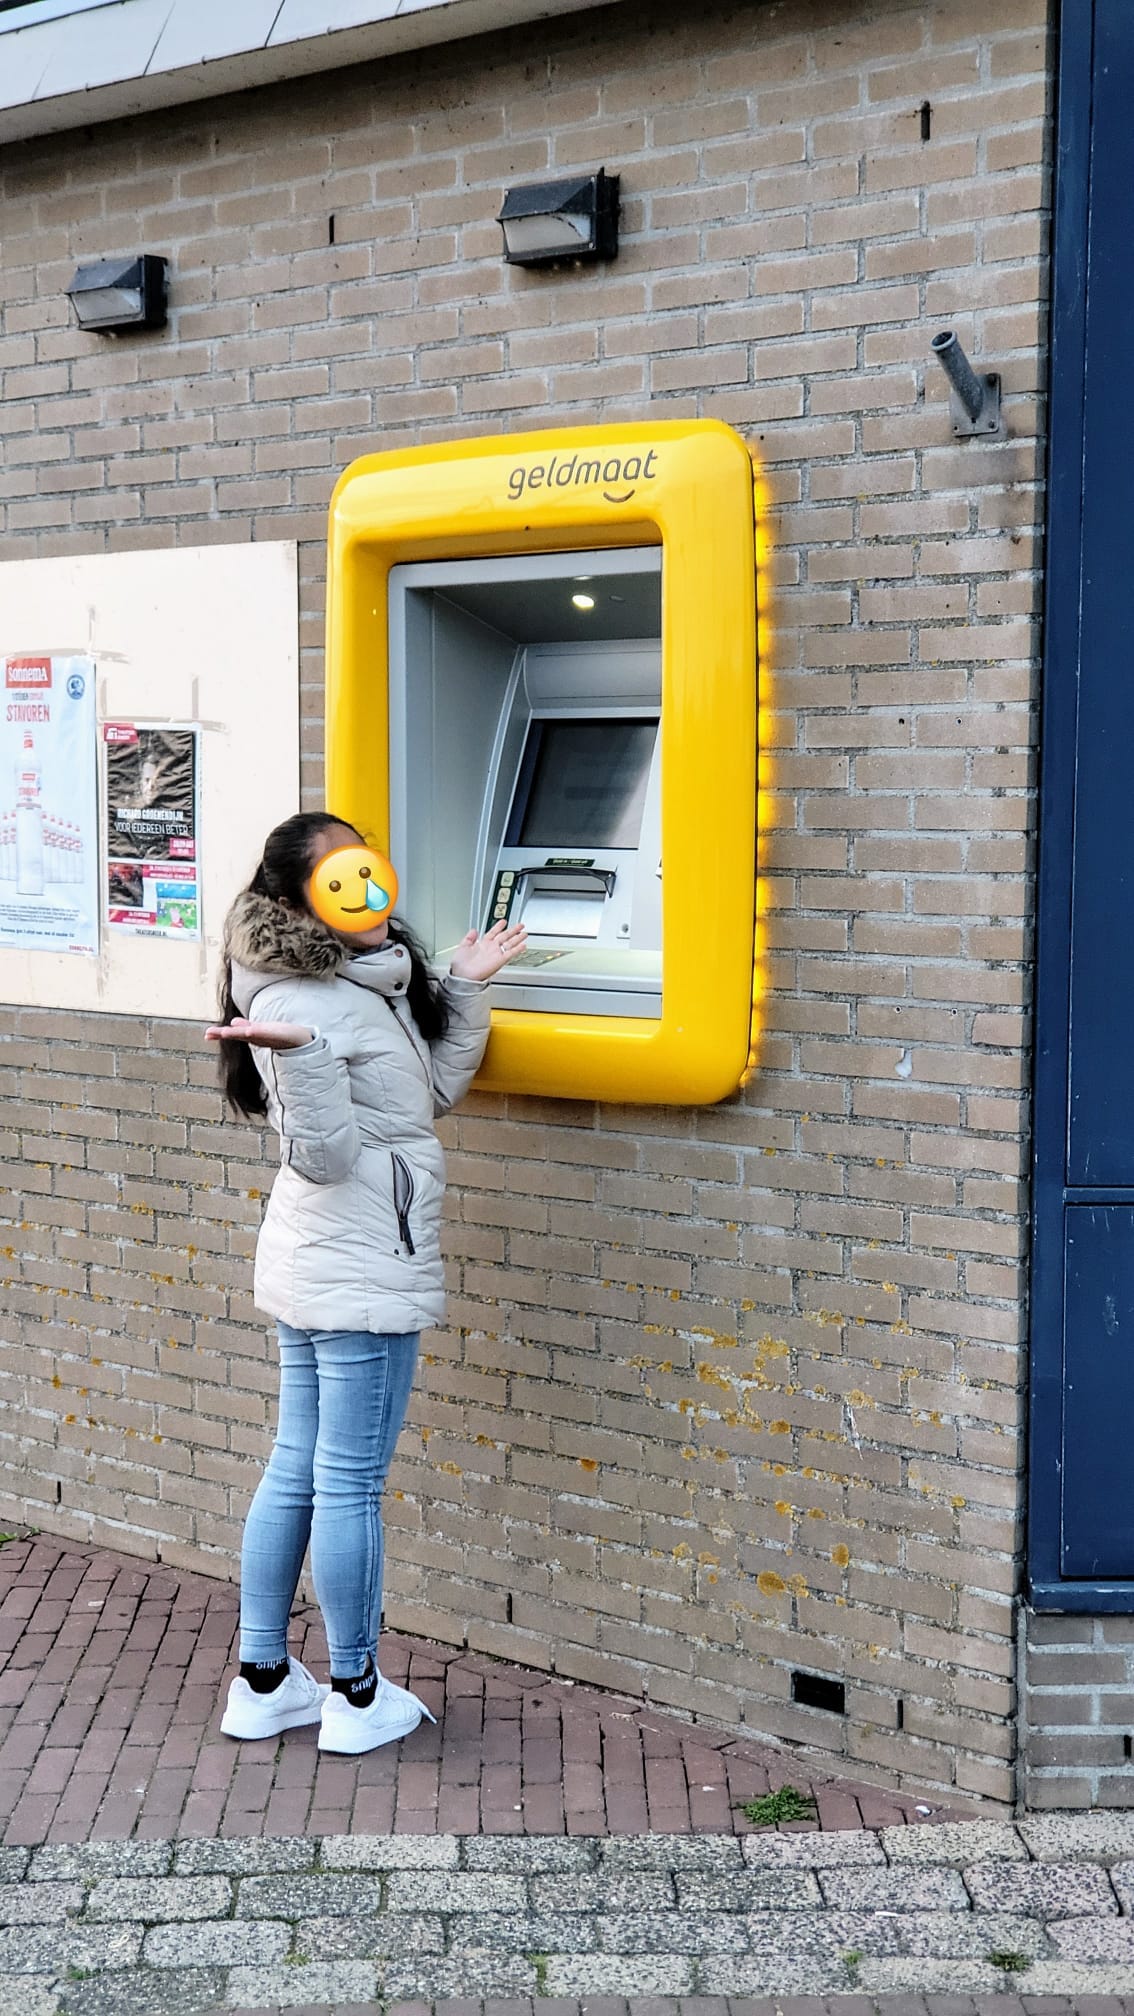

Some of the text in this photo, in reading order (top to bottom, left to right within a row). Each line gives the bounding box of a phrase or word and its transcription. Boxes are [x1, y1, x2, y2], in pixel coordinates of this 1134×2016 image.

[507, 449, 658, 500] geldmaat
[6, 704, 50, 722] STAVOREN
[114, 821, 131, 833] VOOR
[166, 824, 189, 836] BETER
